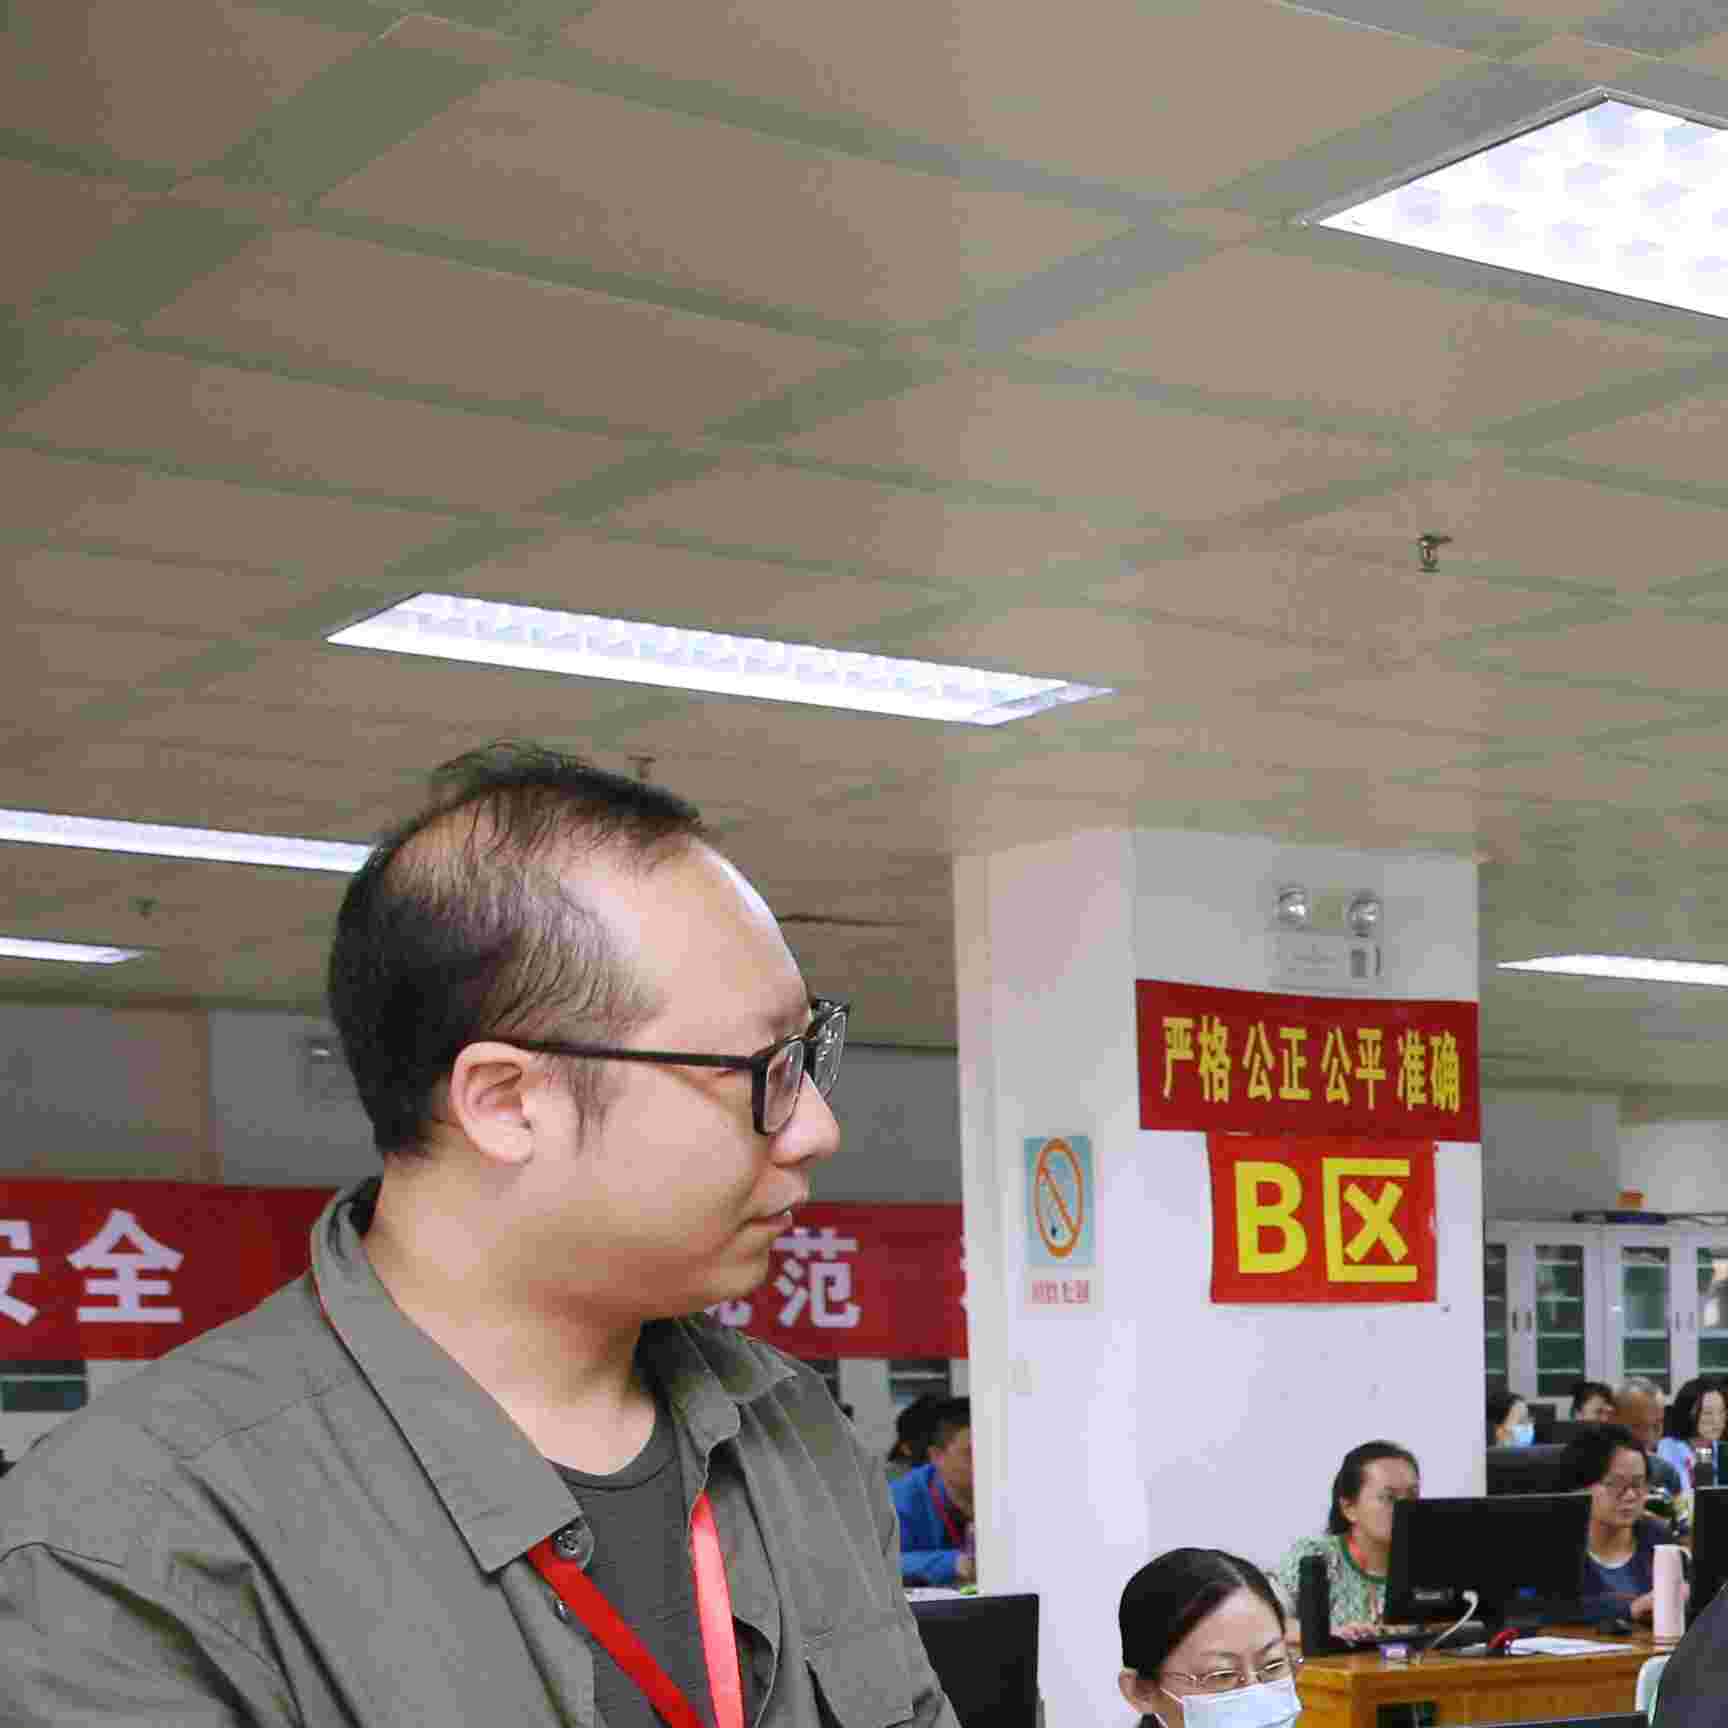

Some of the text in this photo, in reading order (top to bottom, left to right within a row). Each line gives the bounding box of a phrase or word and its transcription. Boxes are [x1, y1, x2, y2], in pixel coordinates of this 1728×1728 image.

[1162, 1015, 1461, 1113] 严格 公正 公平 准确
[1233, 1156, 1419, 1283] B区
